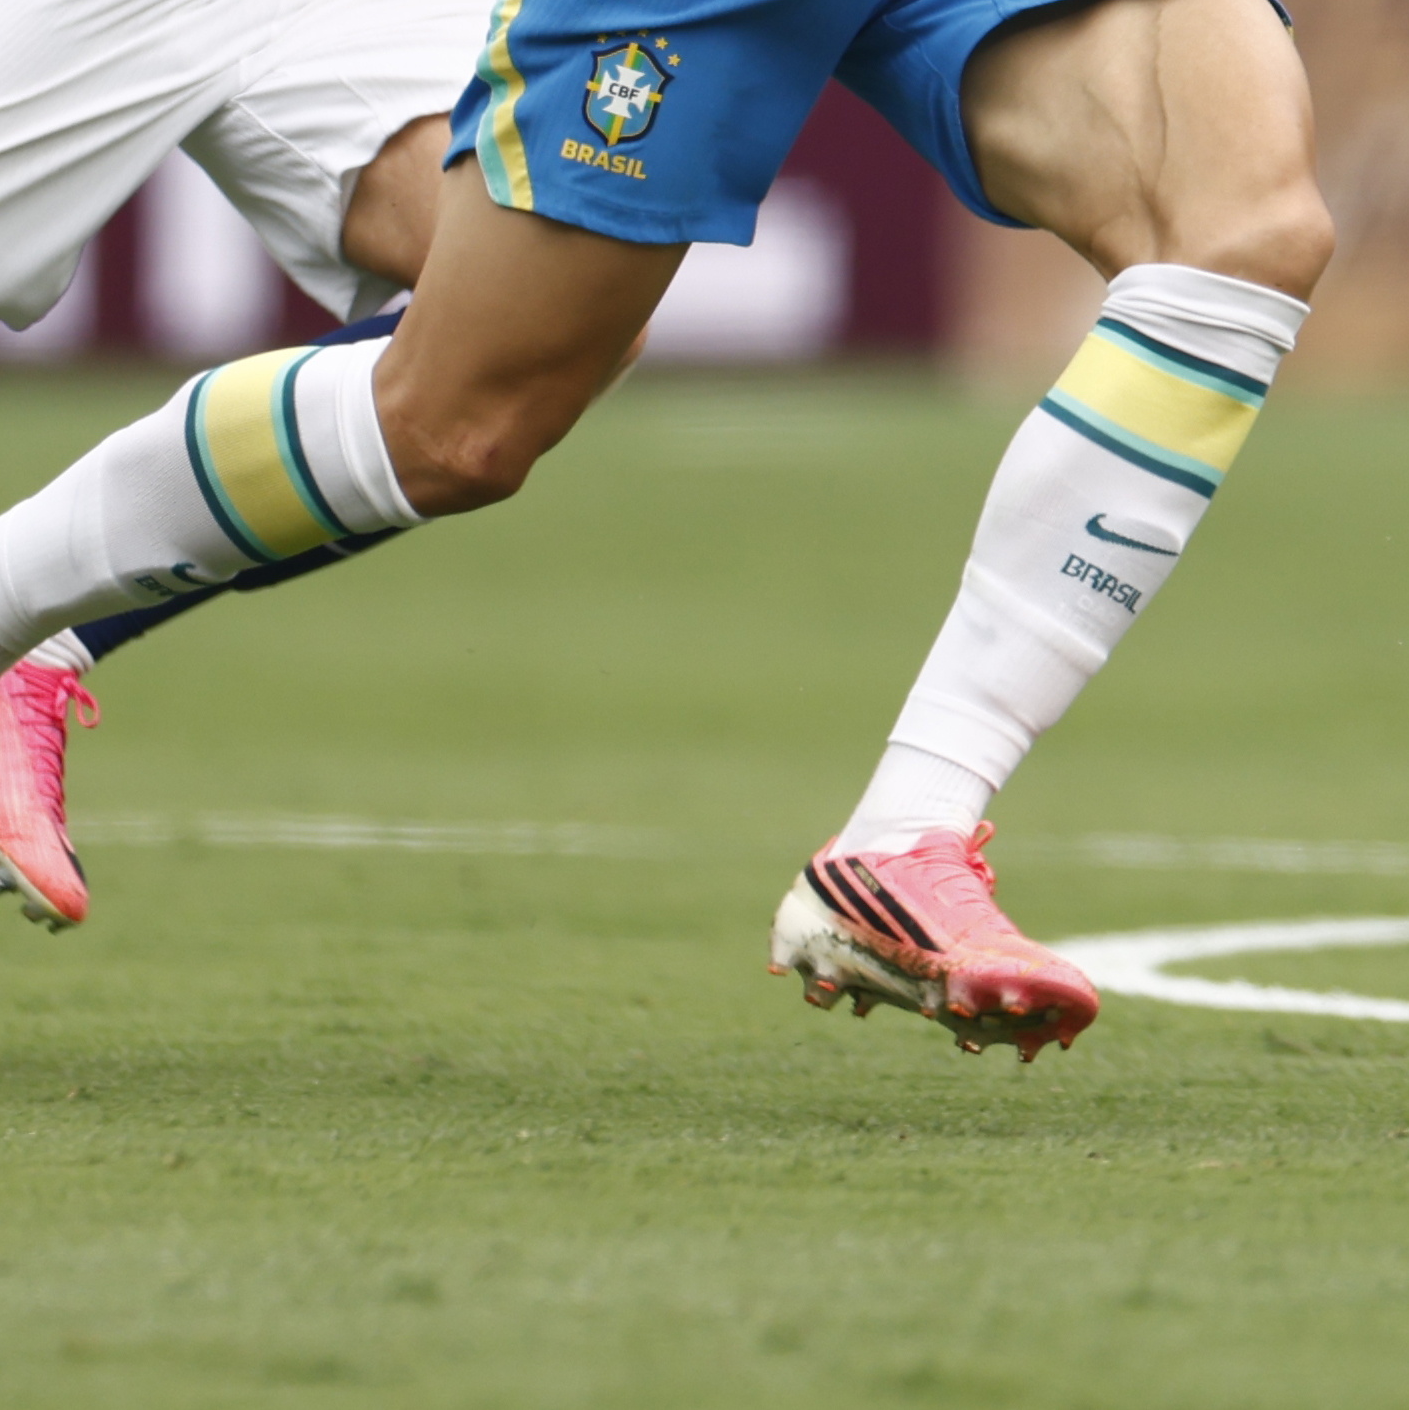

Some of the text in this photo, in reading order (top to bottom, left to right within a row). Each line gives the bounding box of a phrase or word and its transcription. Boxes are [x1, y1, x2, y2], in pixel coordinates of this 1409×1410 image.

[608, 82, 641, 101] CBF
[560, 138, 647, 180] BRASIL
[1060, 553, 1143, 615] BRASIL
